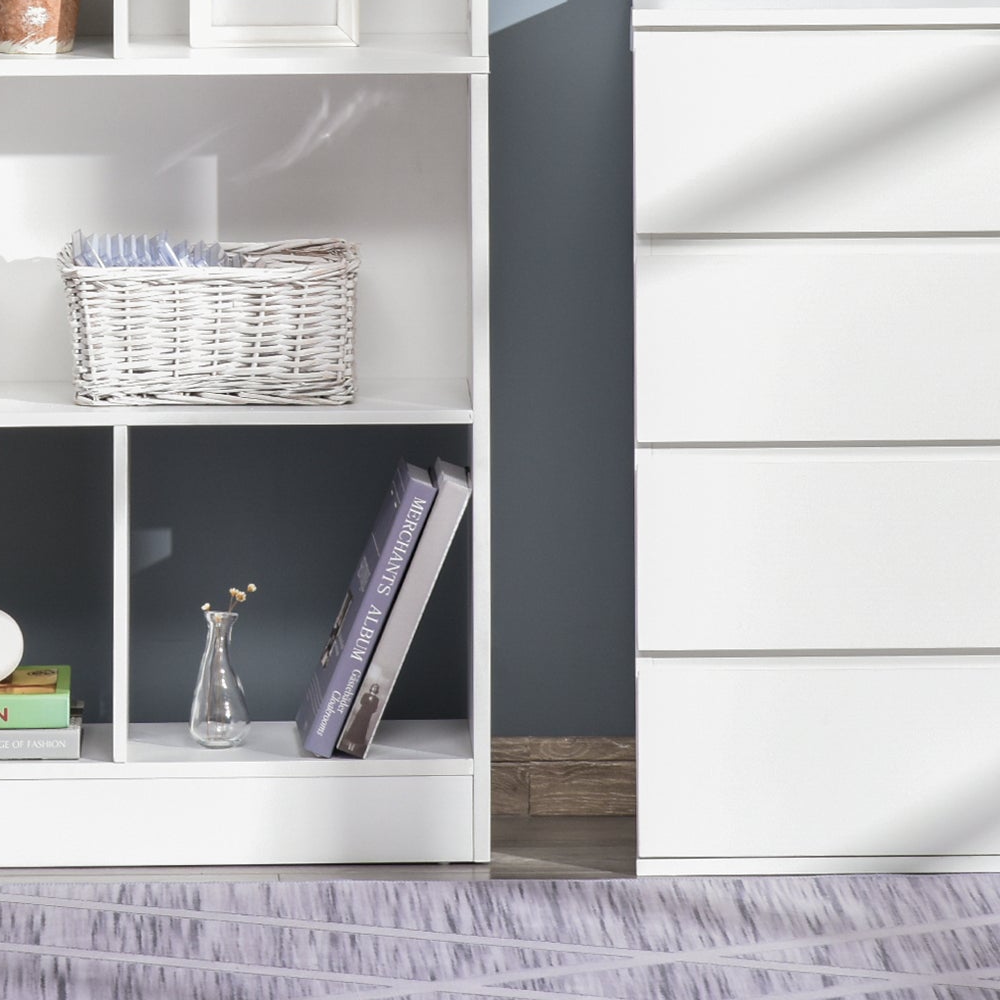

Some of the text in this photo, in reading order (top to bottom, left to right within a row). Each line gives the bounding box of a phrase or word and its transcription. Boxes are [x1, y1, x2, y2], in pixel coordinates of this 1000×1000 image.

[350, 496, 426, 662] MERCHANTS ALBUM
[27, 739, 67, 749] FASHION
